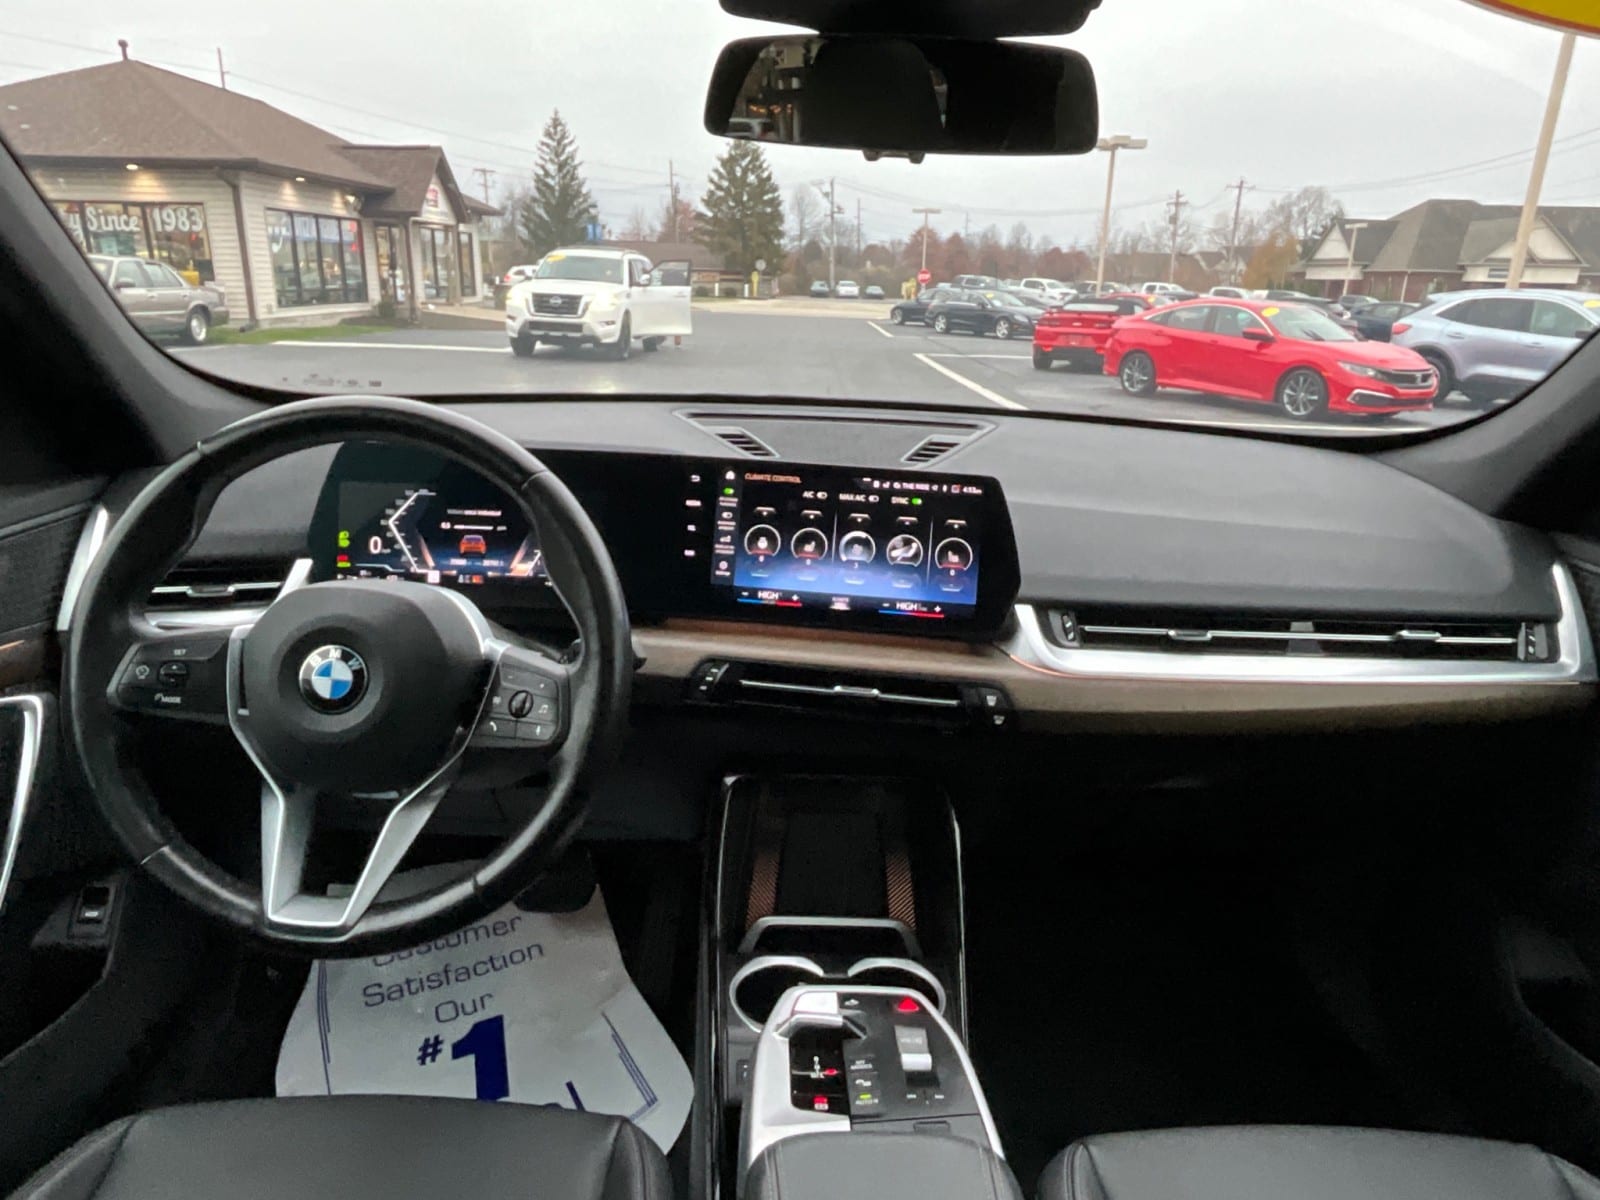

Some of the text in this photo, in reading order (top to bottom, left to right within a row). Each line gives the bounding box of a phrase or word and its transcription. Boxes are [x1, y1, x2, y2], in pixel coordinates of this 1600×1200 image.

[86, 207, 141, 232] Since
[152, 207, 203, 232] 1983
[369, 535, 382, 554] 0
[757, 590, 779, 599] HIGH
[896, 601, 917, 610] HIGH
[308, 648, 362, 670] BMW
[362, 943, 545, 1008] Satisfaction
[434, 992, 494, 1023] Our
